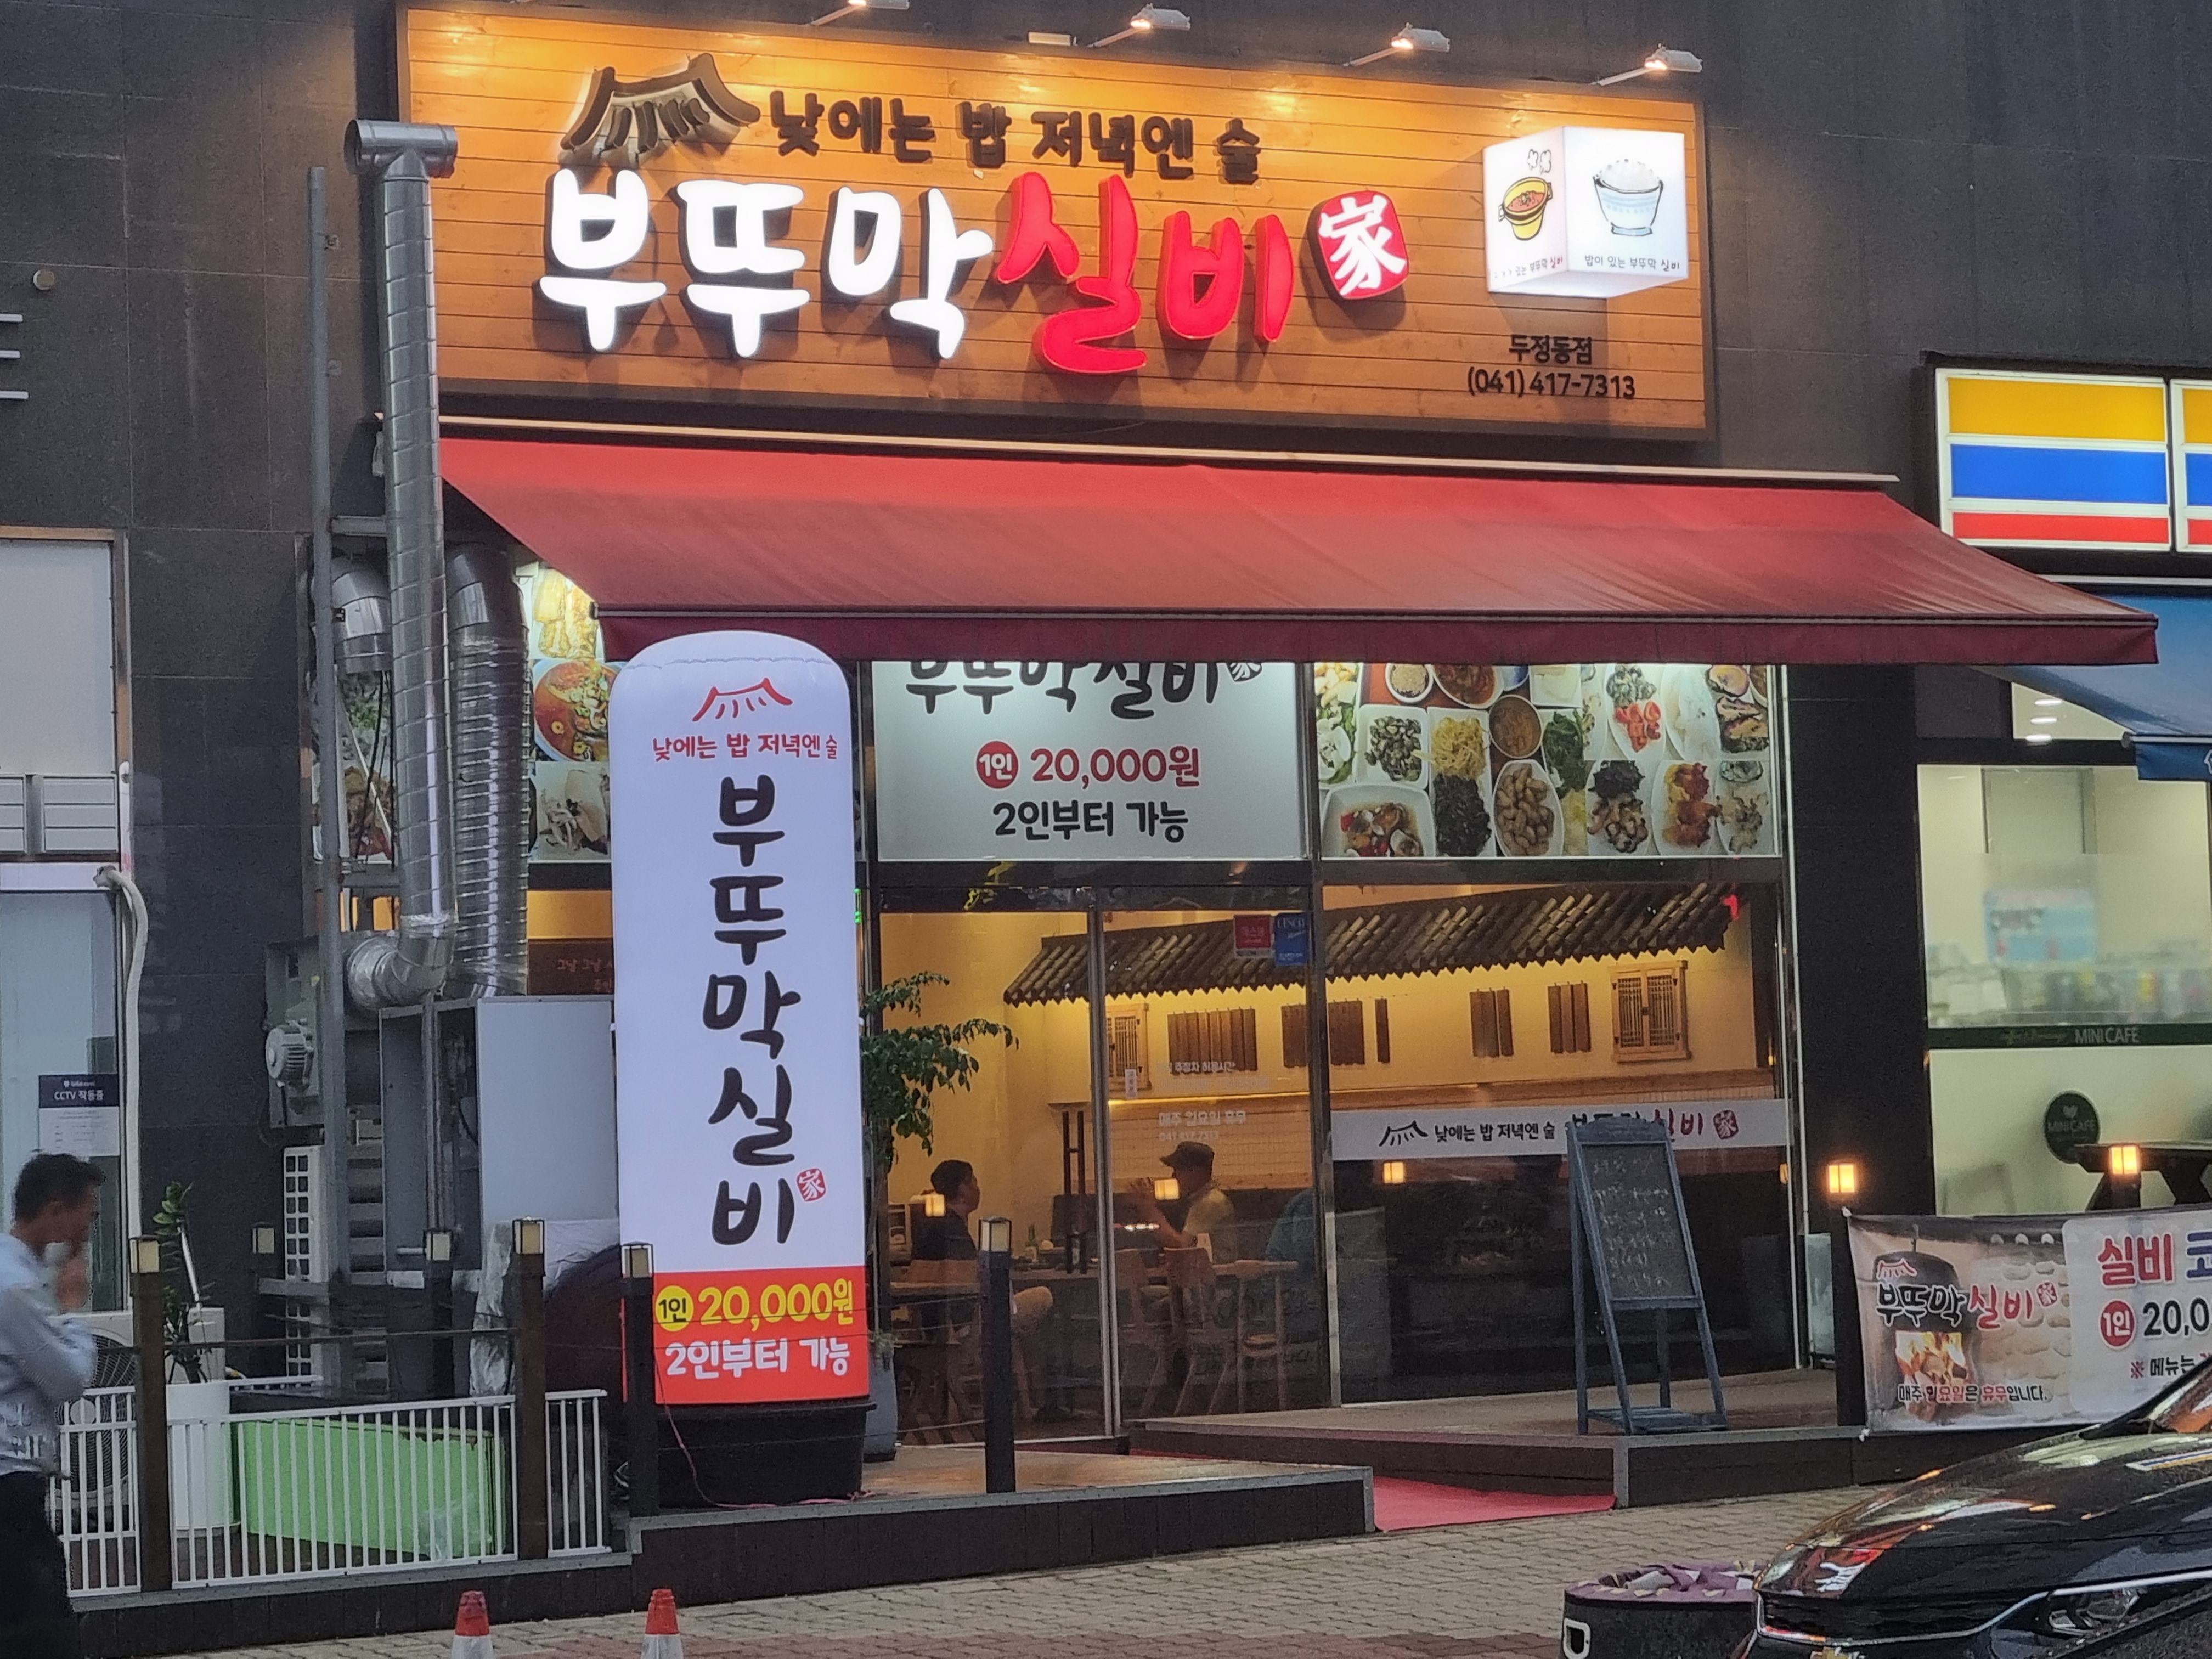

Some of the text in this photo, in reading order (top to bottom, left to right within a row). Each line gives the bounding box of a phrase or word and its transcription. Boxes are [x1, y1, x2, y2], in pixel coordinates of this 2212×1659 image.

[769, 89, 1261, 184] 낮에는 밥 저녁엔 술
[1317, 192, 1408, 300] 家
[1529, 258, 1548, 272] 부뚜막
[1550, 255, 1563, 269] 실비
[1584, 255, 1680, 272] 밥이 있는 부뚜막 실비
[1508, 334, 1593, 365] 두정동점
[652, 732, 838, 762] 낮에는 밥 저녁엔 술
[979, 745, 1200, 790] 1인 20,000원
[992, 799, 1189, 843] 2인부터 가능
[54, 1089, 104, 1102] CCTV 작동중
[1435, 1124, 1475, 1143] 낮에는
[1479, 1123, 1494, 1142] 밥
[1497, 1122, 1539, 1141] 저녁엔
[1543, 1121, 1555, 1140] 술
[797, 1168, 826, 1202] 家
[2097, 1233, 2174, 1286] 실비
[658, 1278, 854, 1332] 1인 20,000원
[2102, 1310, 2132, 1338] 1인
[665, 1336, 850, 1380] 2인부터 가능
[2149, 1355, 2196, 1376] 메뉴는
[1899, 1385, 2048, 1403] 매주 일요일은 휴무입니다.
